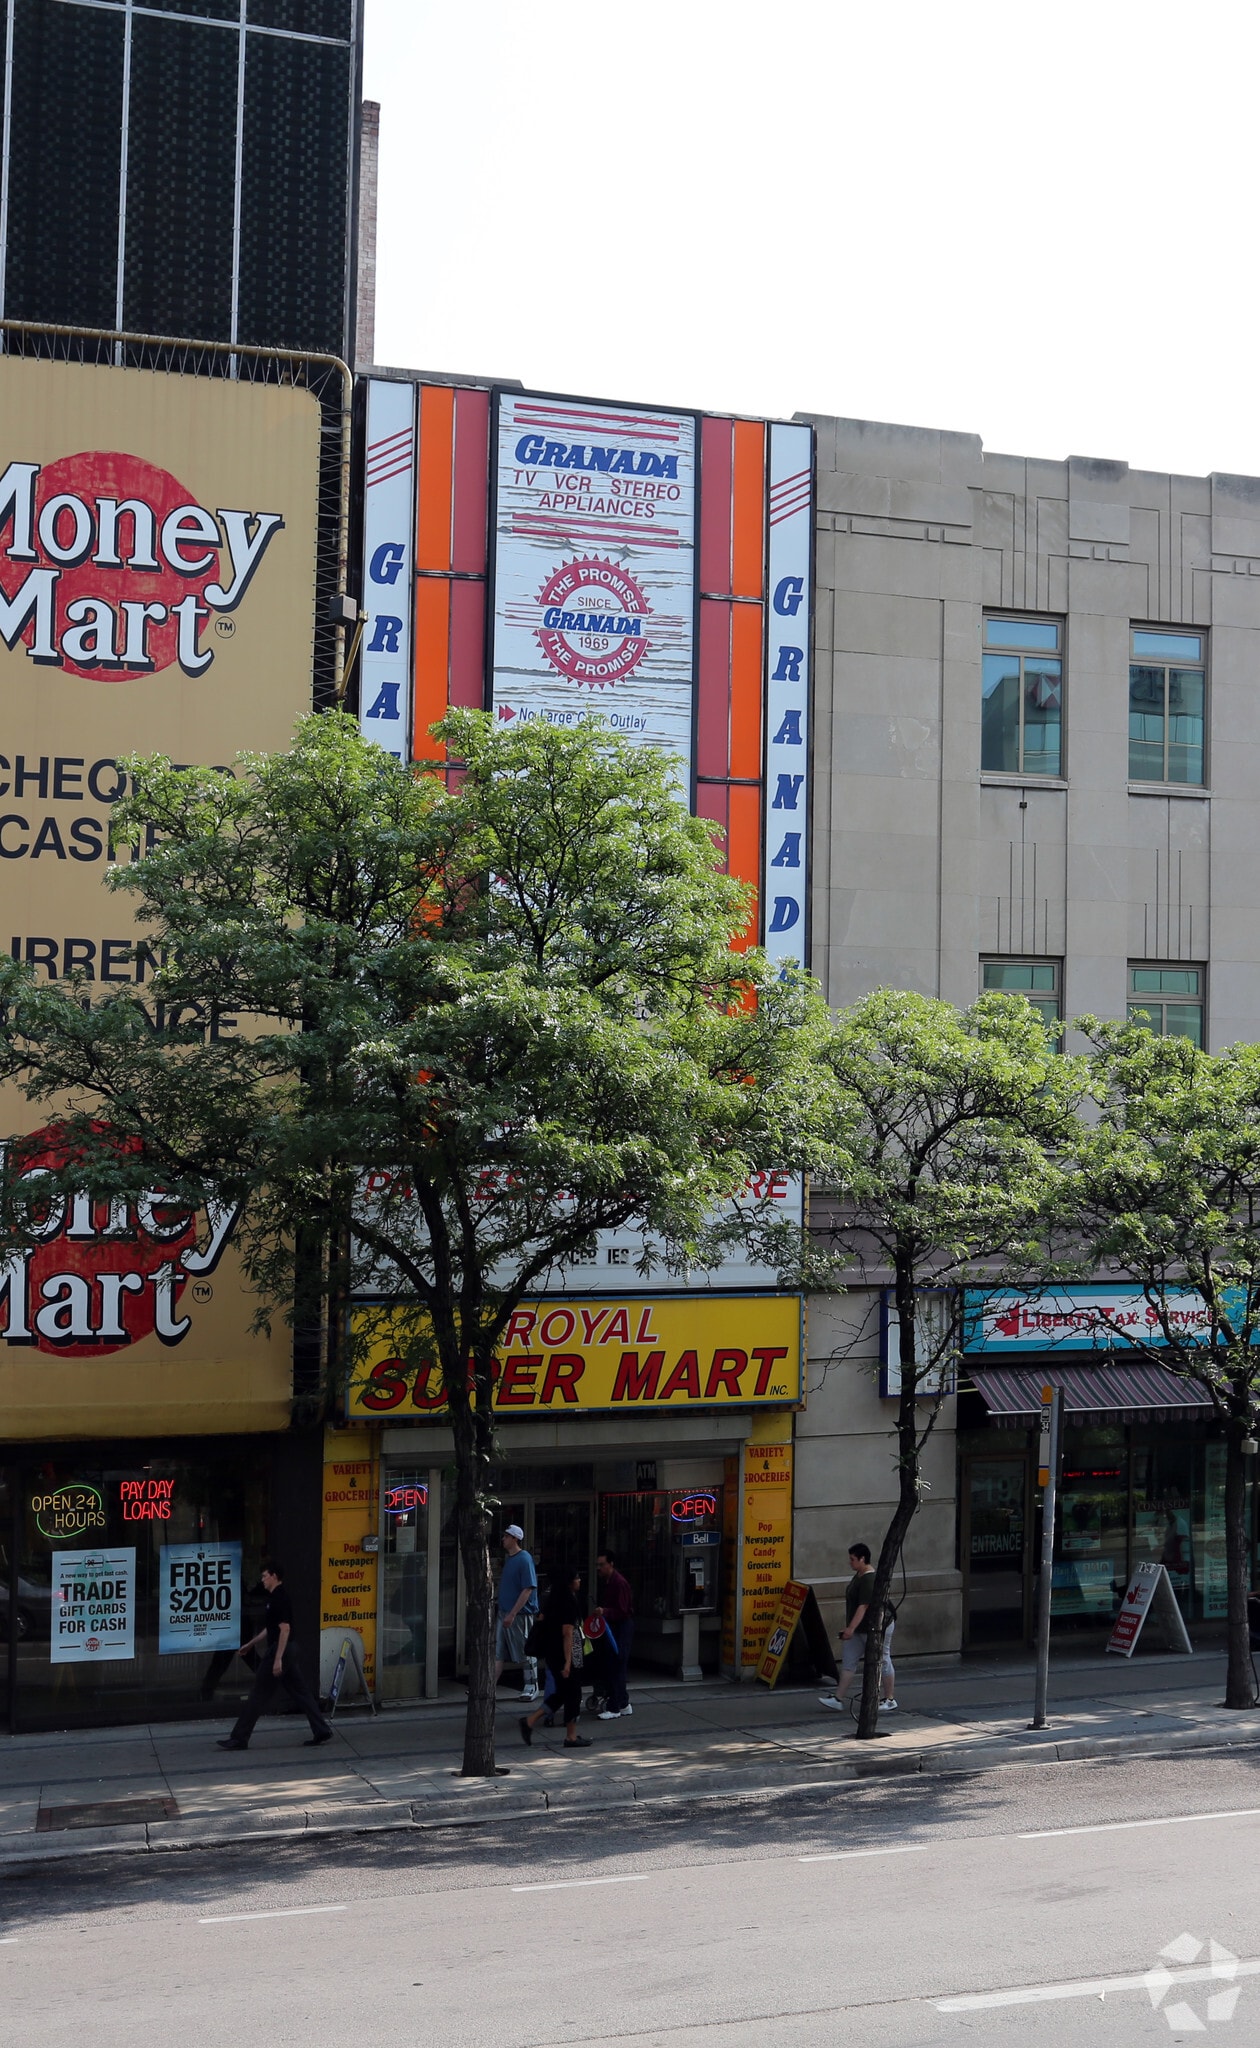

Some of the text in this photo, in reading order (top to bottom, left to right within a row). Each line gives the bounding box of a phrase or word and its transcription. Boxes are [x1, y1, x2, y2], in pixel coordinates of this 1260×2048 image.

[515, 434, 678, 479] GRANADA
[513, 469, 681, 501] TV VCR STEREO
[539, 493, 656, 518] APPLIANCES
[548, 568, 640, 613] THE PROMISE
[578, 597, 611, 608] SINCE
[0, 568, 214, 678] Mart
[218, 622, 233, 631] TM
[543, 607, 641, 635] GRANADA
[579, 637, 609, 649] 1969
[548, 633, 639, 676] THE PROMISE
[540, 709, 572, 723] Large
[610, 713, 647, 731] Outlay
[769, 575, 805, 985] GRANAD
[0, 1140, 247, 1277] oney
[1022, 1309, 1096, 1328] LIBERTY
[1101, 1307, 1137, 1326] TAX
[503, 1306, 660, 1348] ROYAL
[610, 1346, 789, 1402] MART
[768, 1385, 789, 1396] INC.
[749, 1447, 784, 1458] VARIETY
[333, 1464, 373, 1475] VARIETY
[637, 1464, 656, 1479] ATM
[763, 1460, 769, 1470] &
[349, 1477, 357, 1487] &
[744, 1472, 790, 1483] GROCERIES
[120, 1479, 175, 1500] PAY DAY
[31, 1494, 96, 1512] OPEN 24
[123, 1501, 171, 1520] LOANS
[671, 1499, 715, 1517] OPEN
[54, 1510, 106, 1528] HOURS
[758, 1522, 772, 1532] Pop
[693, 1533, 709, 1544] Bell
[745, 1535, 784, 1546] Newspaper
[972, 1532, 1022, 1553] ENTRANCE
[753, 1548, 776, 1558] Candy
[328, 1557, 374, 1567] Newspaper
[747, 1560, 781, 1570] Groceries
[170, 1560, 231, 1587] FREE
[338, 1570, 365, 1580] Candy
[756, 1573, 773, 1582] Milk
[60, 1580, 127, 1602] TRADE
[331, 1584, 371, 1594] Groceries
[170, 1586, 231, 1613] $200
[341, 1597, 361, 1607] Milk
[60, 1603, 127, 1617] GIFT CARDS
[170, 1612, 231, 1624] CASH ADVANCE
[59, 1617, 127, 1634] FOR CASH
